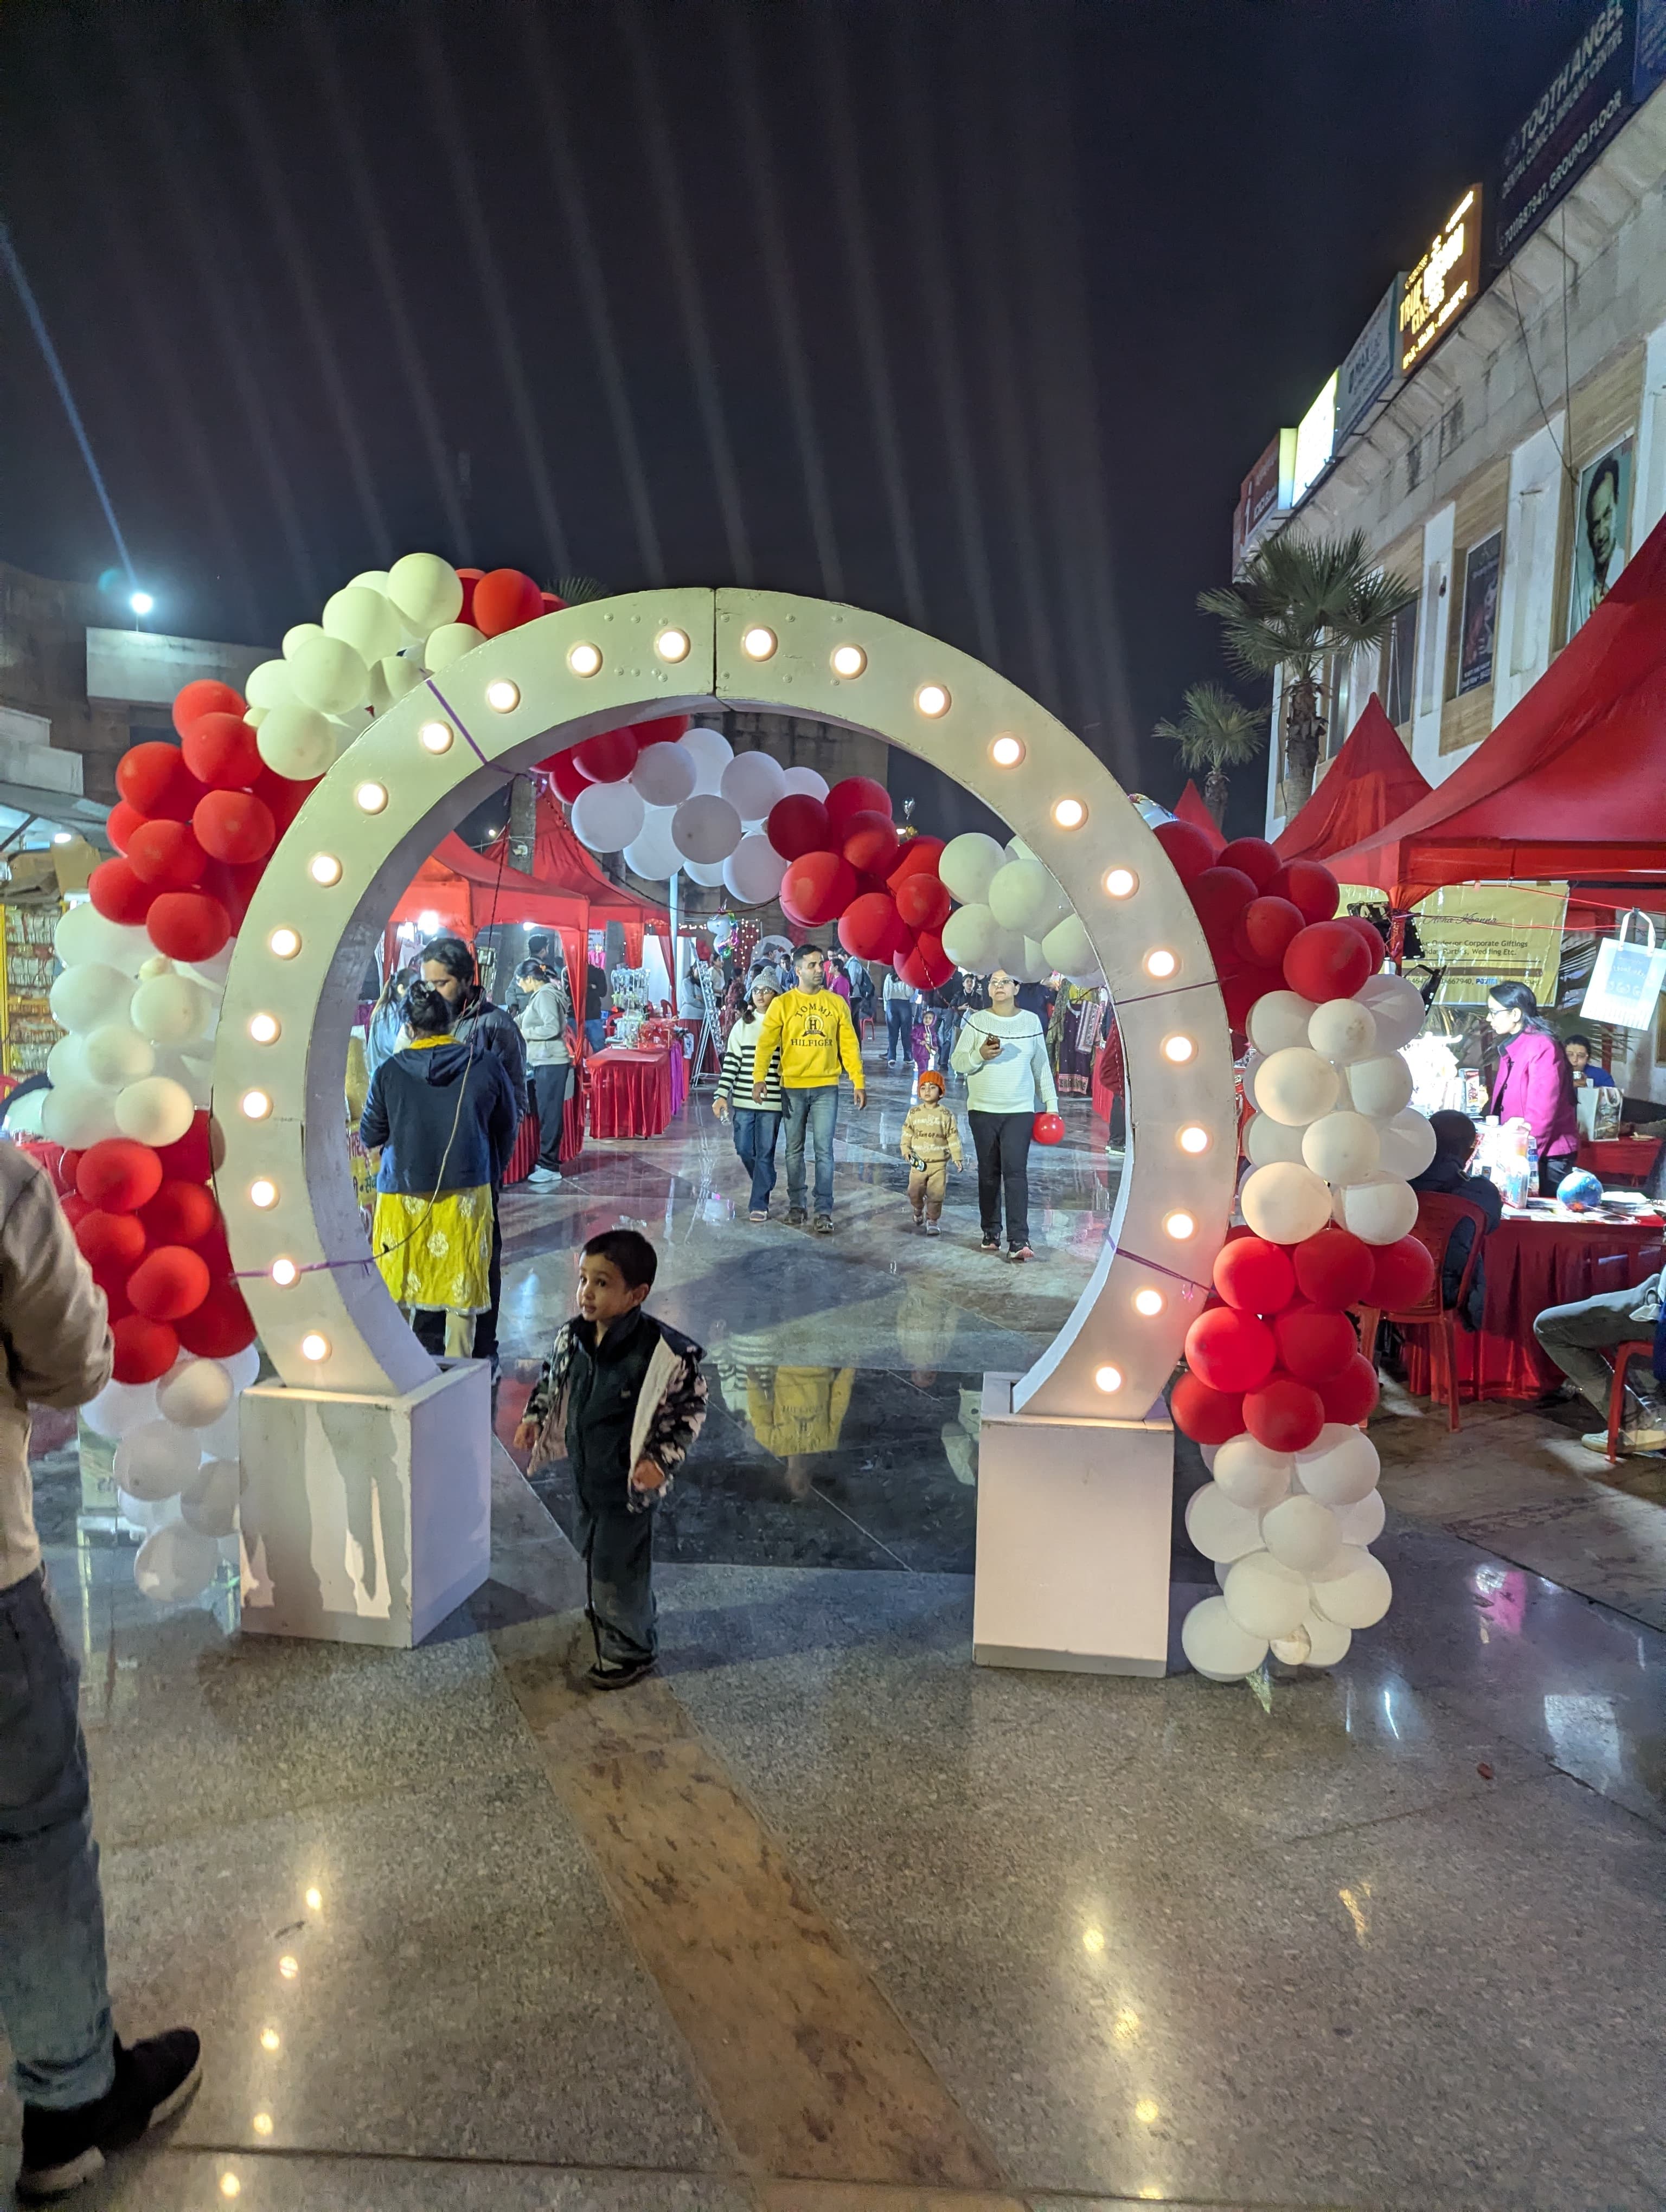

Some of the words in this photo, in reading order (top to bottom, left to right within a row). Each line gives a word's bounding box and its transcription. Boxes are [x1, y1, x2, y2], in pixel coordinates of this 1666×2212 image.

[1549, 133, 1588, 189] GROUND
[1589, 89, 1621, 143] FLOOR
[1400, 277, 1423, 332] TRUE
[1501, 940, 1528, 948] Giftings
[795, 1002, 832, 1017] TOMMY
[810, 1019, 817, 1030] H
